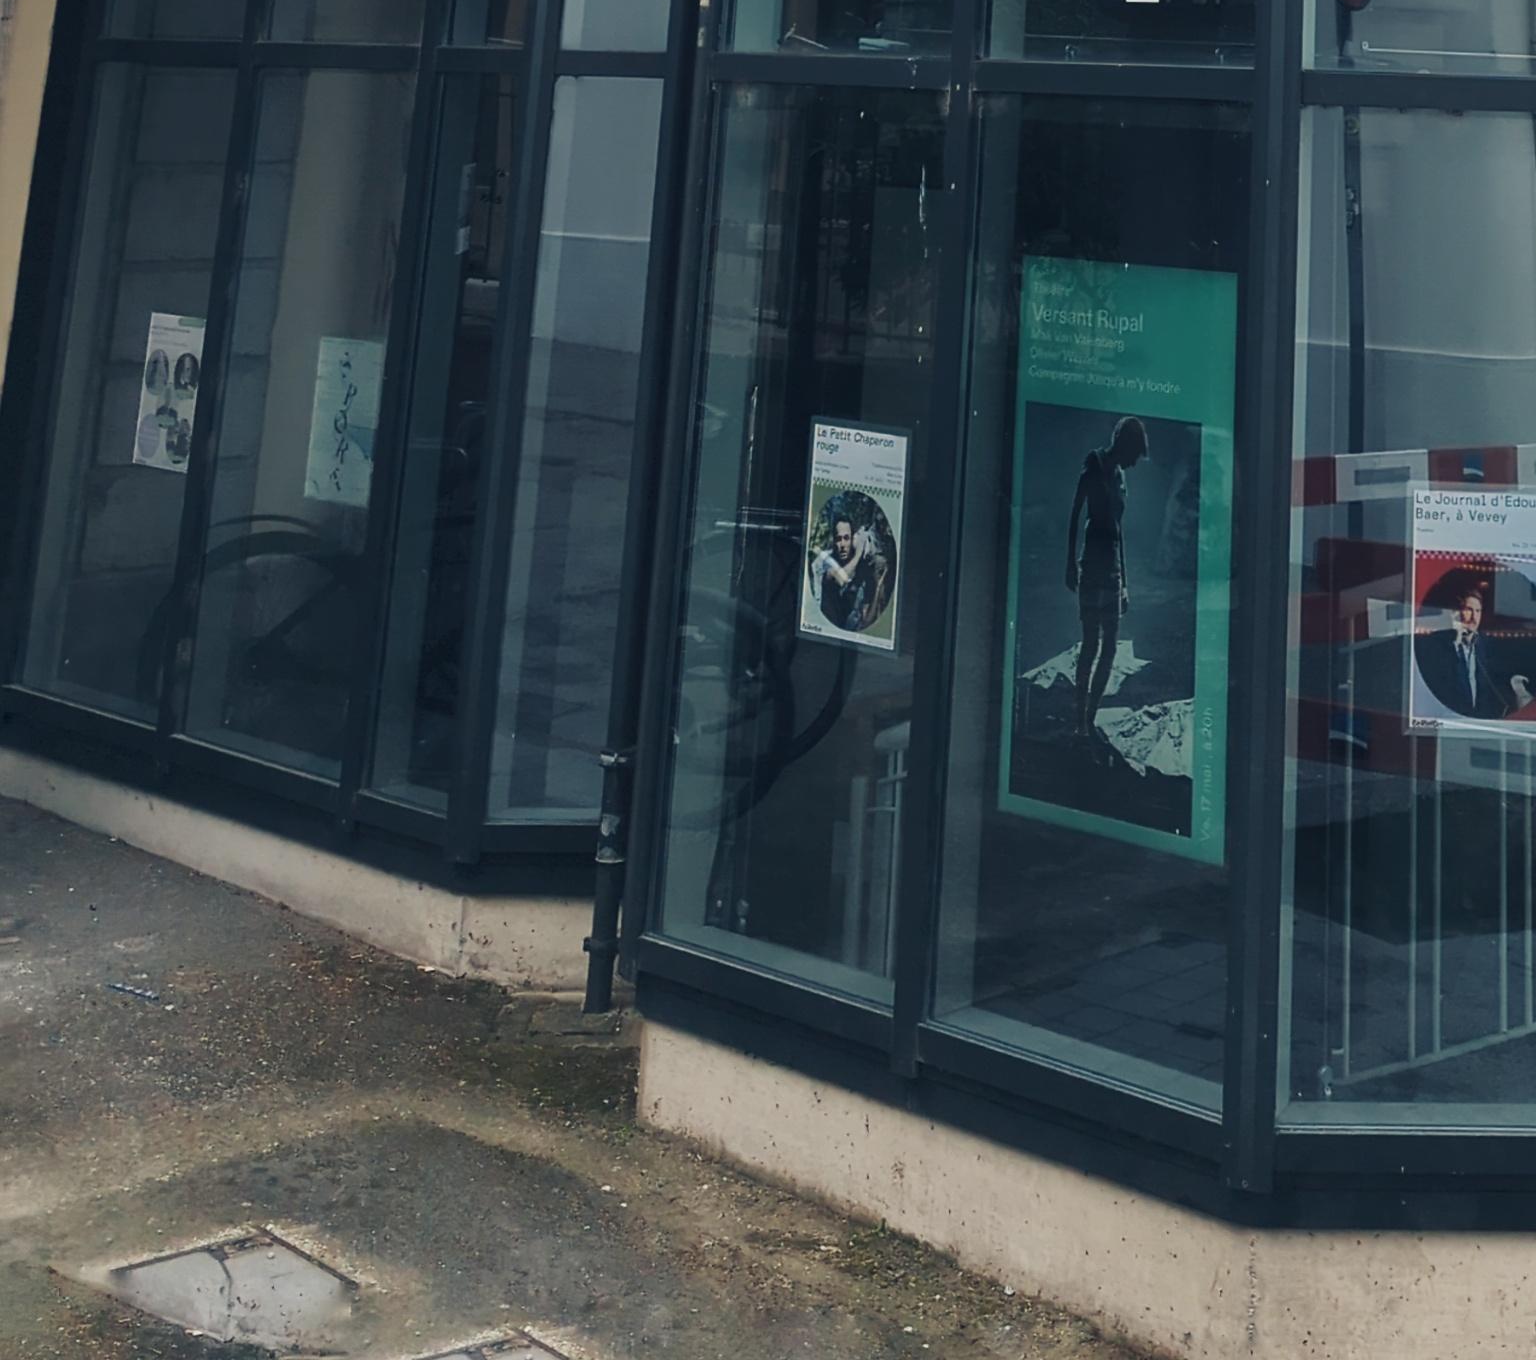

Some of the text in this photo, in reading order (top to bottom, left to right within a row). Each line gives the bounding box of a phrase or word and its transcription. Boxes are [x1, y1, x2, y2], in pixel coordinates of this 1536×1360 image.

[1032, 302, 1144, 334] Versant Rupal
[816, 426, 895, 448] Le Petit Chaperon
[816, 440, 839, 454] rouge
[1415, 492, 1431, 504] Le
[1435, 492, 1486, 507] Journal
[1415, 507, 1507, 525] Baer, à Vevey
